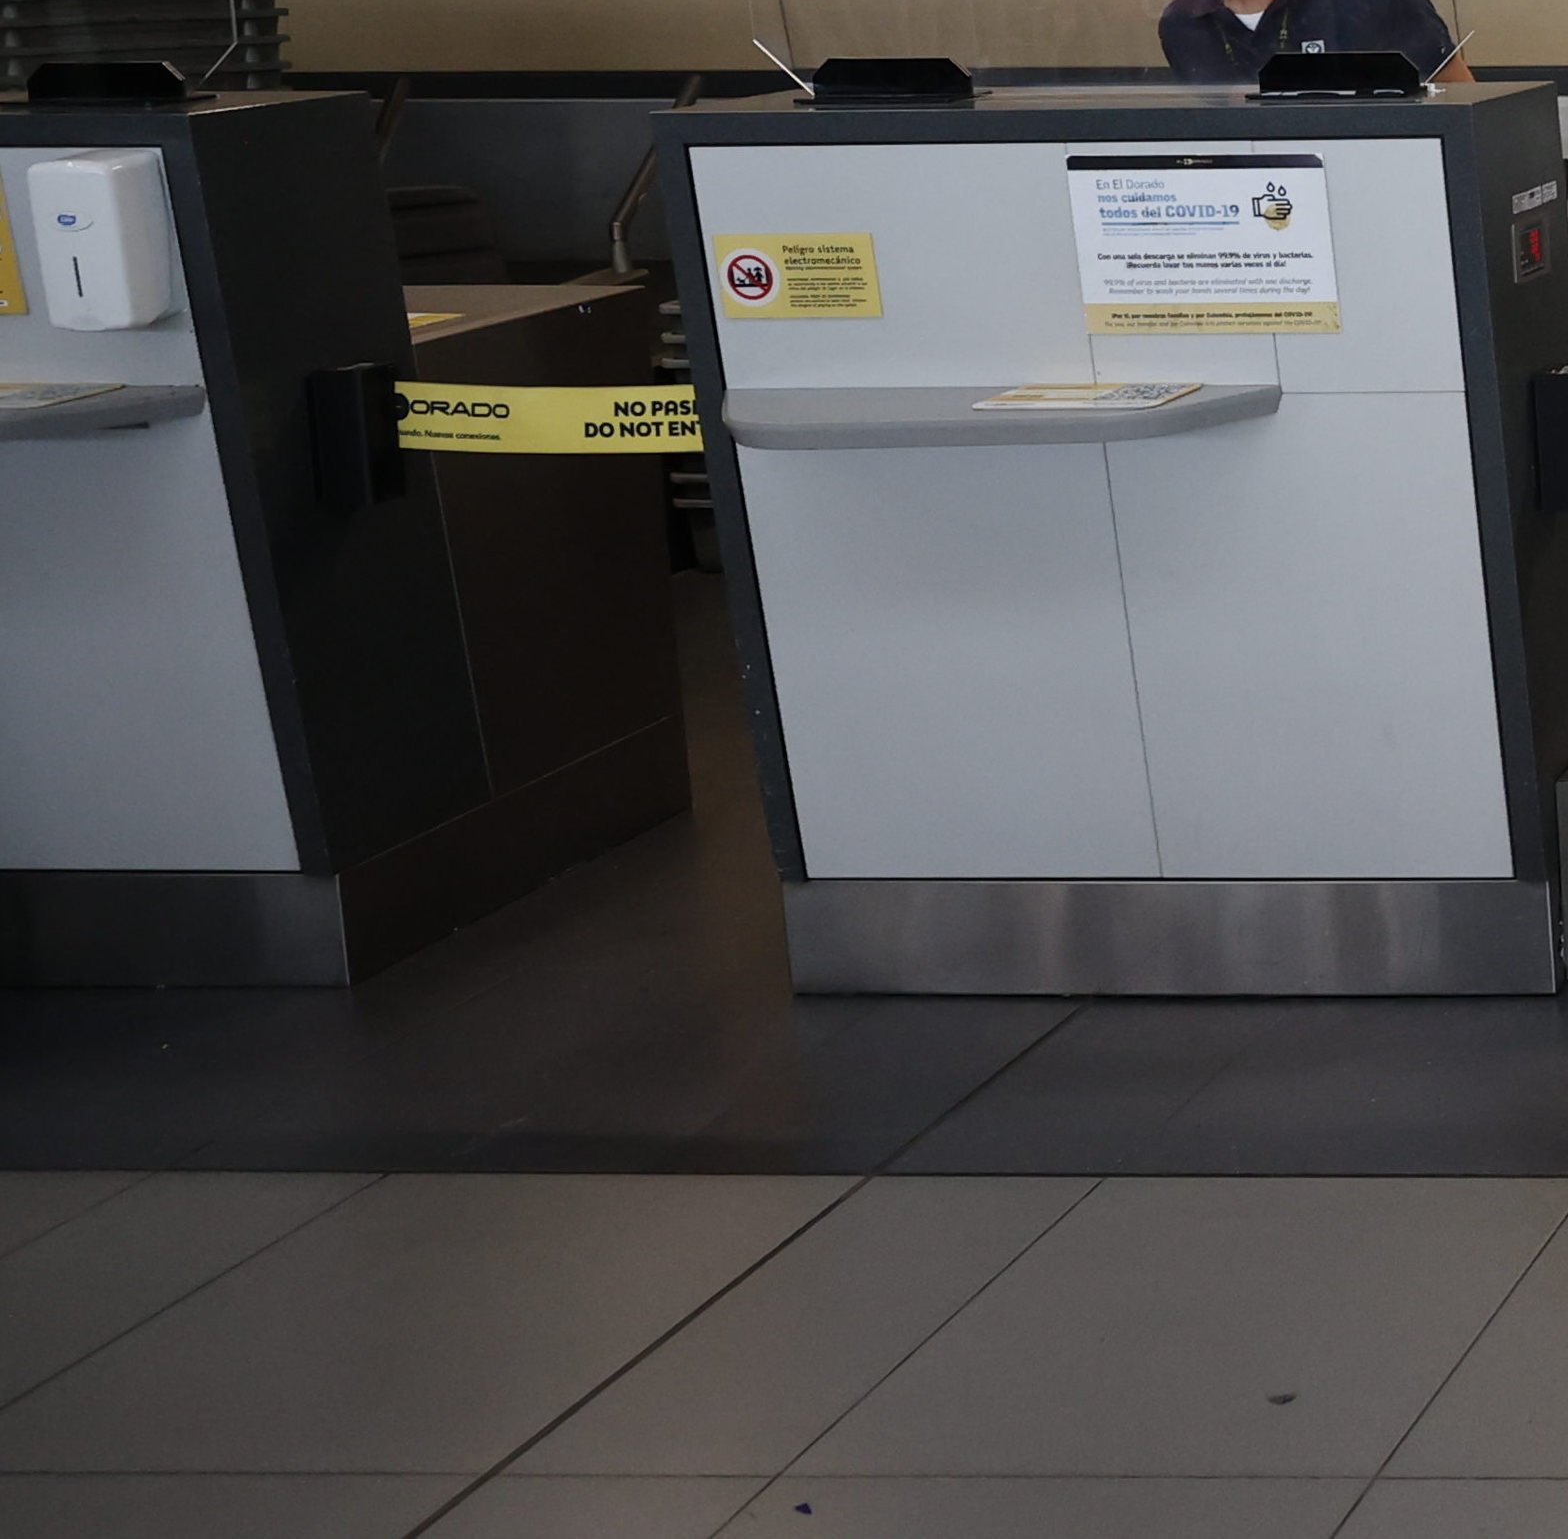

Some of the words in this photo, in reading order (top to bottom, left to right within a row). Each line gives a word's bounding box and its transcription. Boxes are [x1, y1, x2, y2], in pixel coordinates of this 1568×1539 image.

[1096, 179, 1110, 190] En
[1112, 179, 1123, 190] El
[1125, 178, 1165, 190] Dorado
[1097, 194, 1118, 203] nos
[1121, 192, 1177, 203] cuidamos
[1099, 207, 1138, 219] todos
[1141, 206, 1162, 219] del
[1165, 204, 1240, 219] COVID-19
[782, 245, 814, 255] Peligro
[817, 245, 854, 253] sistema
[784, 256, 861, 265] electromecánico
[614, 401, 646, 417] NO
[584, 422, 614, 438] DO
[620, 422, 663, 438] NOT
